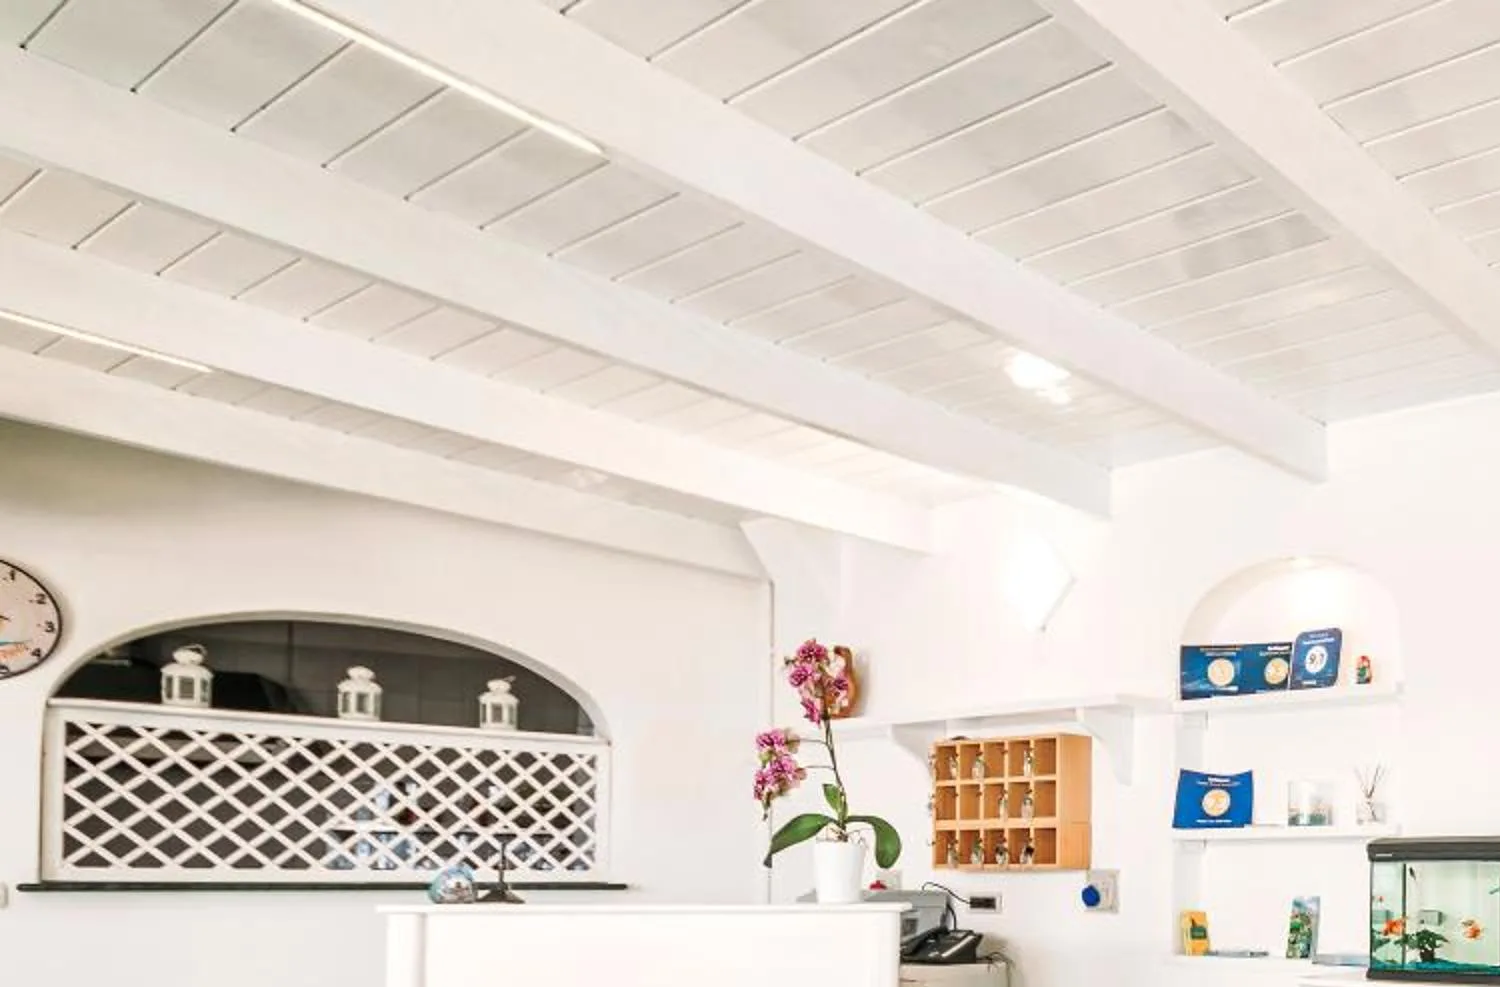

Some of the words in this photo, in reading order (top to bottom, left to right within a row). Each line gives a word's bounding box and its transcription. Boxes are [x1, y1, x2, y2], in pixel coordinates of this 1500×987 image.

[36, 593, 46, 605] 2
[44, 620, 55, 633] 3
[30, 647, 41, 659] 4
